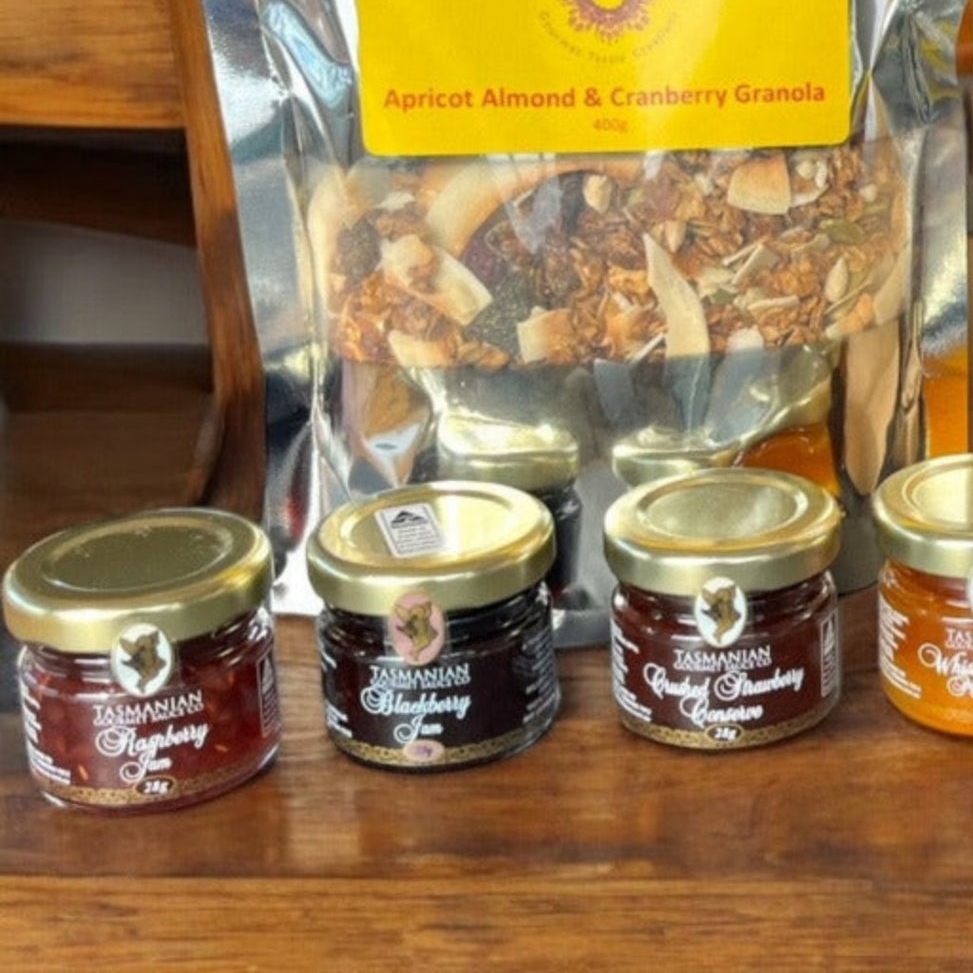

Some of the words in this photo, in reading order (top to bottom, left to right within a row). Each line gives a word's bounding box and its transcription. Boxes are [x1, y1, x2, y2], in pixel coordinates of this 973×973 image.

[383, 88, 474, 114] Apricot
[481, 86, 577, 108] Almond
[584, 87, 602, 107] &
[610, 84, 728, 110] Cranberry
[734, 81, 826, 105] Granola
[593, 117, 629, 134] 400g
[673, 645, 771, 670] TASMANIAN
[369, 662, 469, 688] TASMANIAN
[714, 667, 804, 702] Strawberry
[93, 689, 203, 724] TASMANIAN
[361, 687, 472, 719] Blackberry
[679, 694, 764, 728] Conserve
[95, 722, 209, 761] Raspberry
[393, 714, 443, 744] Jam
[119, 753, 172, 784] Jam
